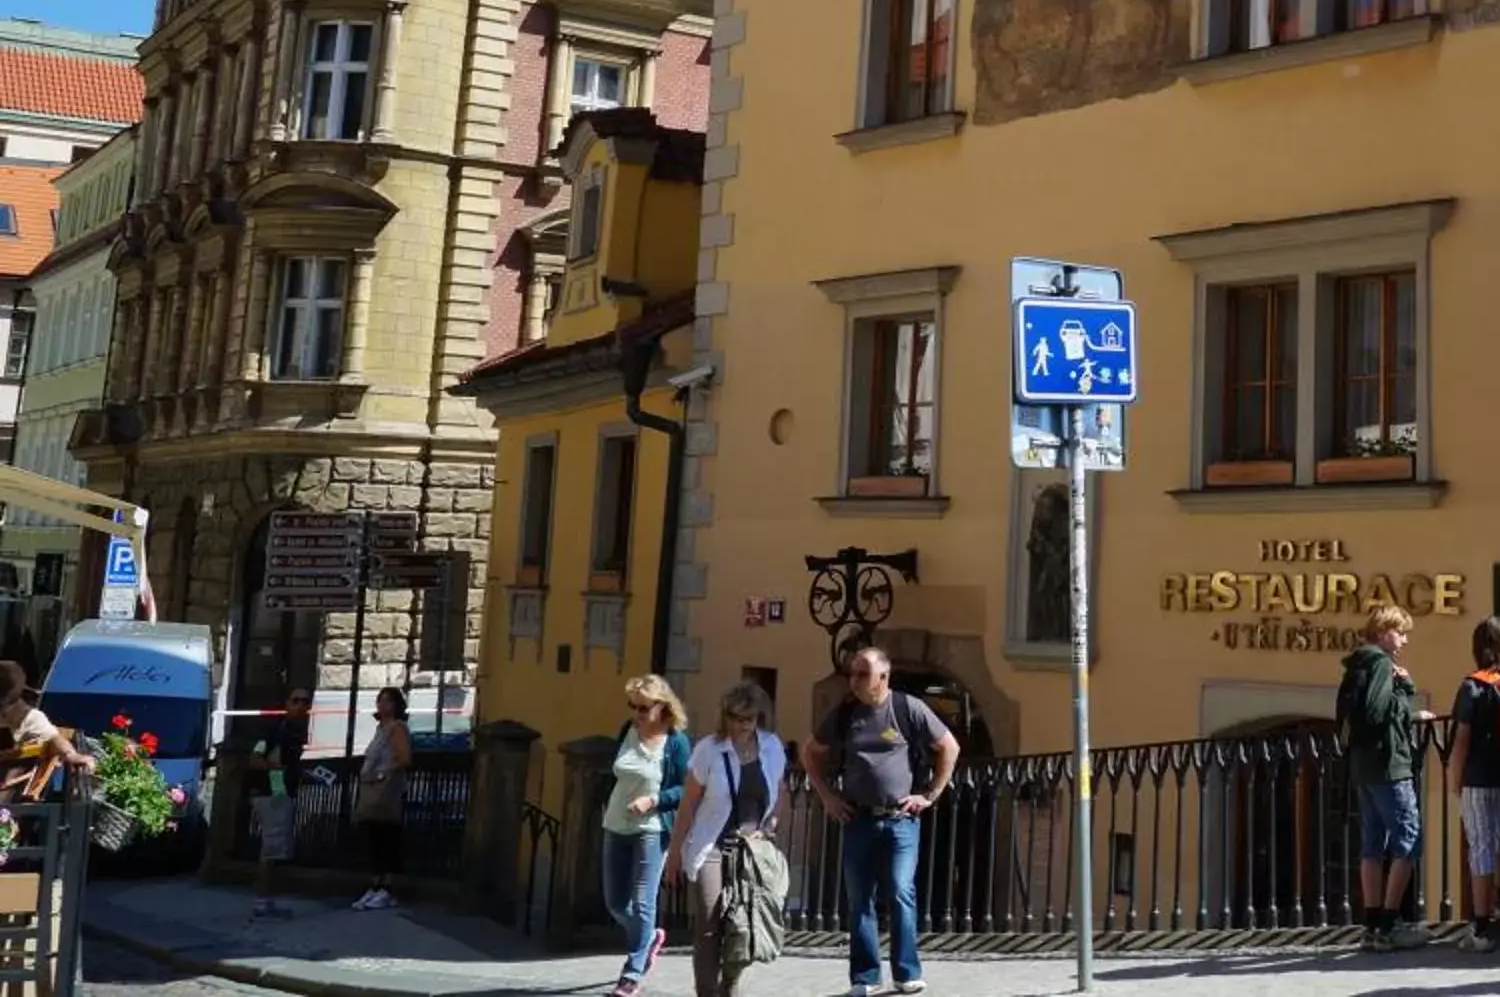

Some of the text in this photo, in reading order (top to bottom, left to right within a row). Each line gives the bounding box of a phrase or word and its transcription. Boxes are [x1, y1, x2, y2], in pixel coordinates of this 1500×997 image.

[113, 546, 135, 571] P
[1260, 539, 1350, 562] HOTEL
[1160, 570, 1465, 616] RESTAURACE
[1223, 622, 1240, 650] U
